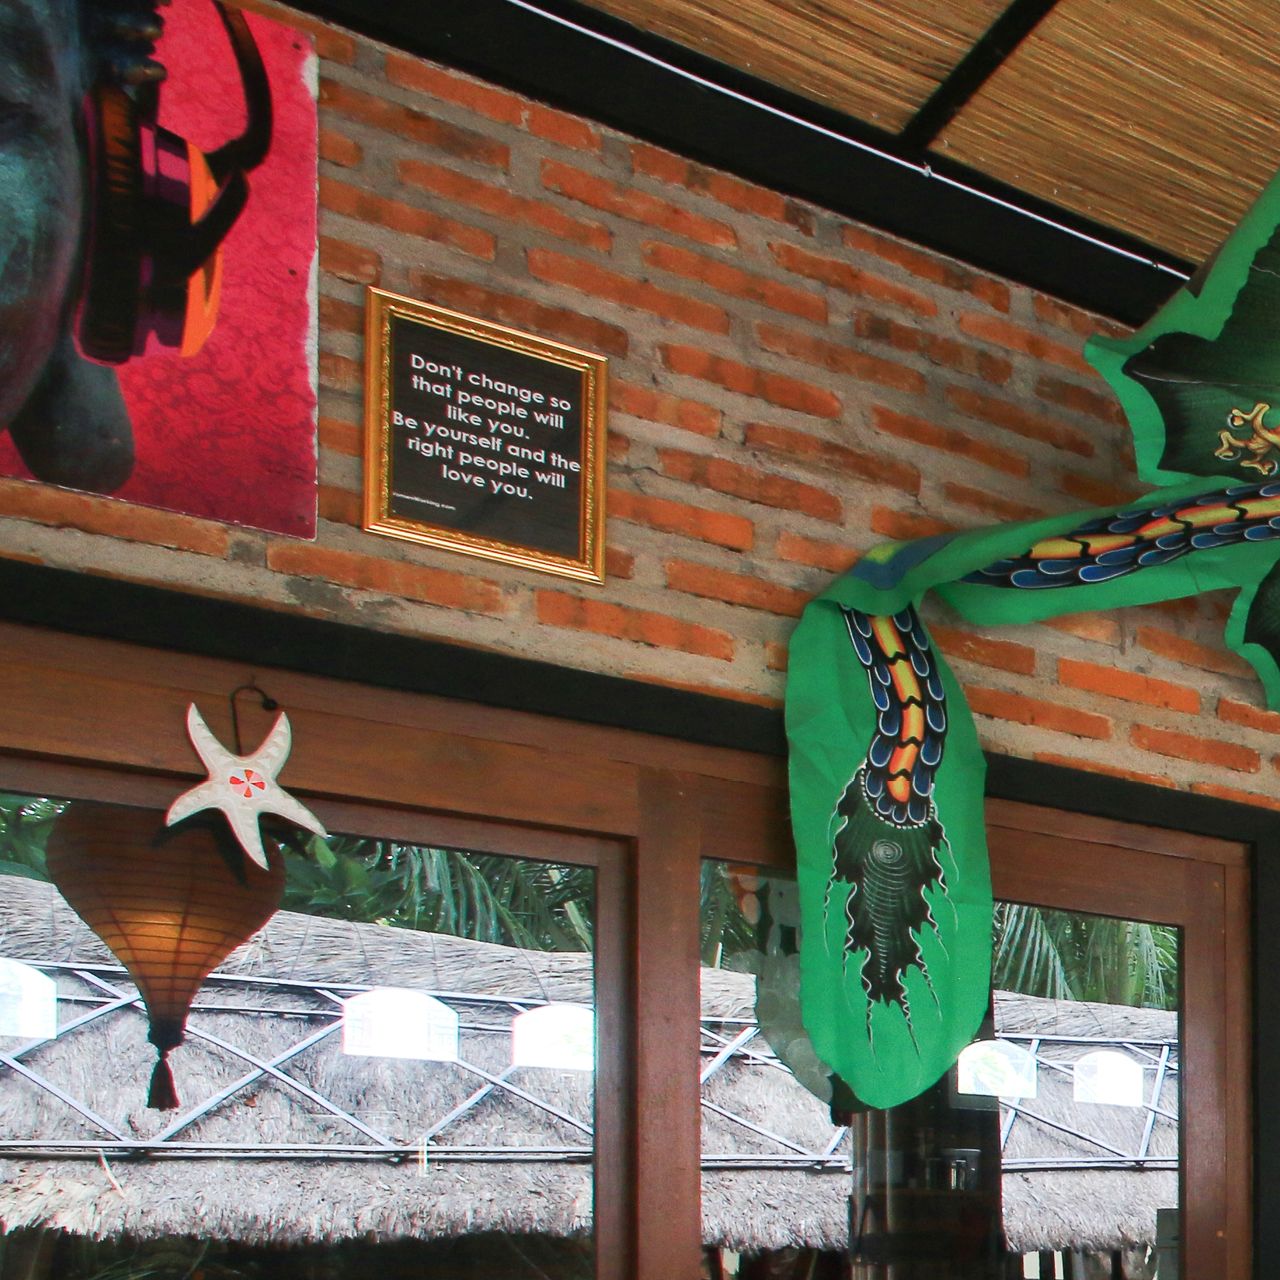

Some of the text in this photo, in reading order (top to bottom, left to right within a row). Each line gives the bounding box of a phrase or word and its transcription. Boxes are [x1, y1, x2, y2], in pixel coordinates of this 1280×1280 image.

[411, 375, 563, 428] that people will
[412, 354, 571, 411] Don't change so
[393, 411, 582, 473] Be yourself and the
[447, 405, 530, 440] like you.
[407, 437, 565, 488] right people will
[443, 464, 533, 500] love you.
